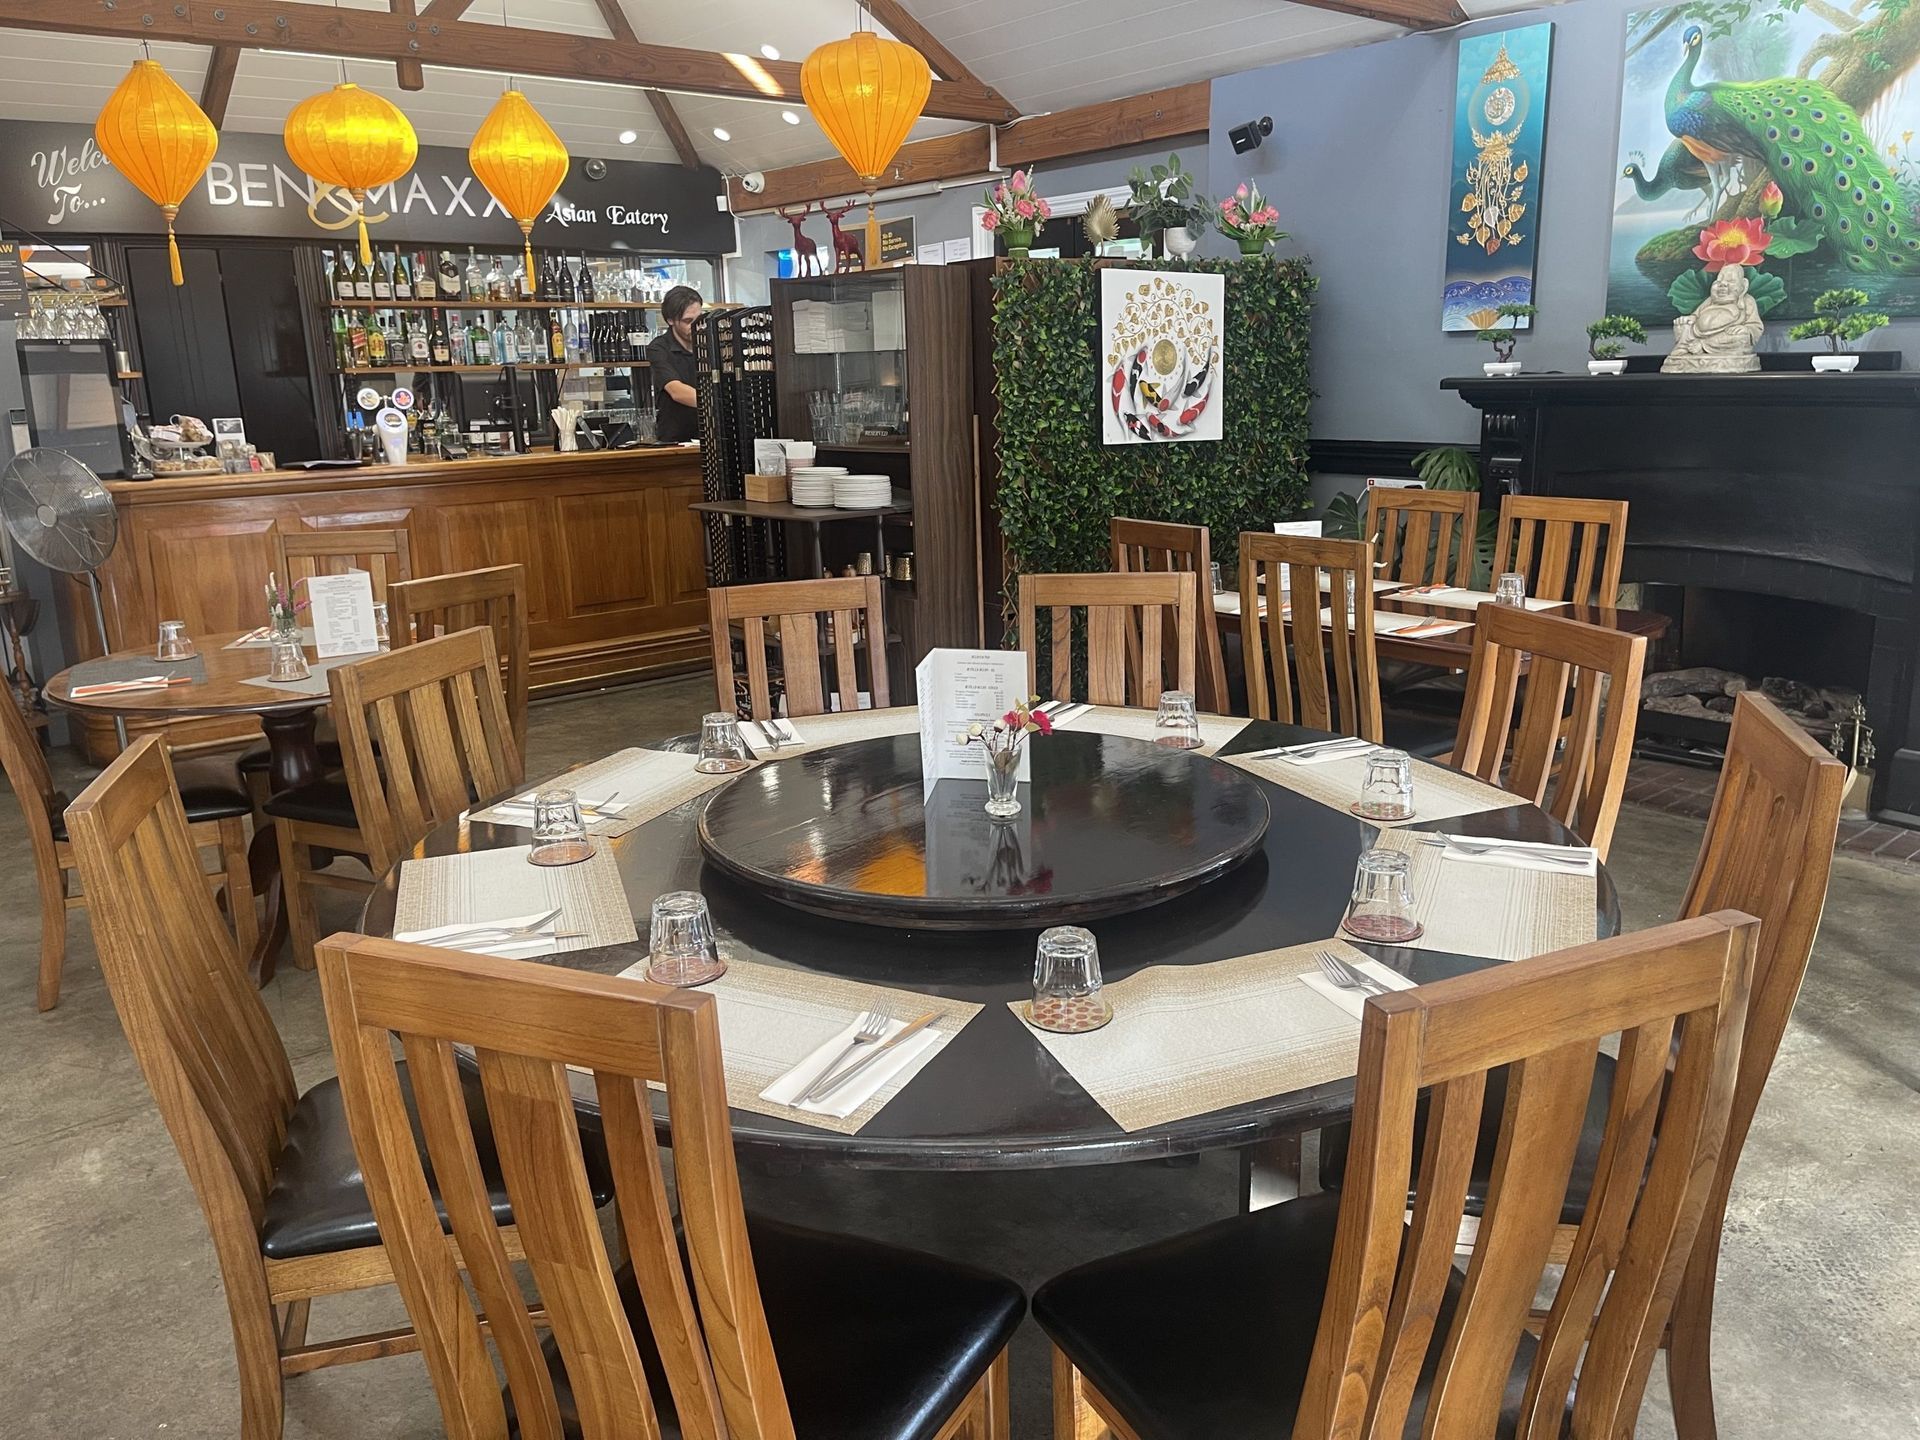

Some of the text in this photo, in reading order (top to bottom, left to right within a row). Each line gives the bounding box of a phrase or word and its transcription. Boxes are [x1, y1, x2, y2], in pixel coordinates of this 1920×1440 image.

[31, 138, 111, 188] Welc
[545, 202, 670, 234] Asian Eatery
